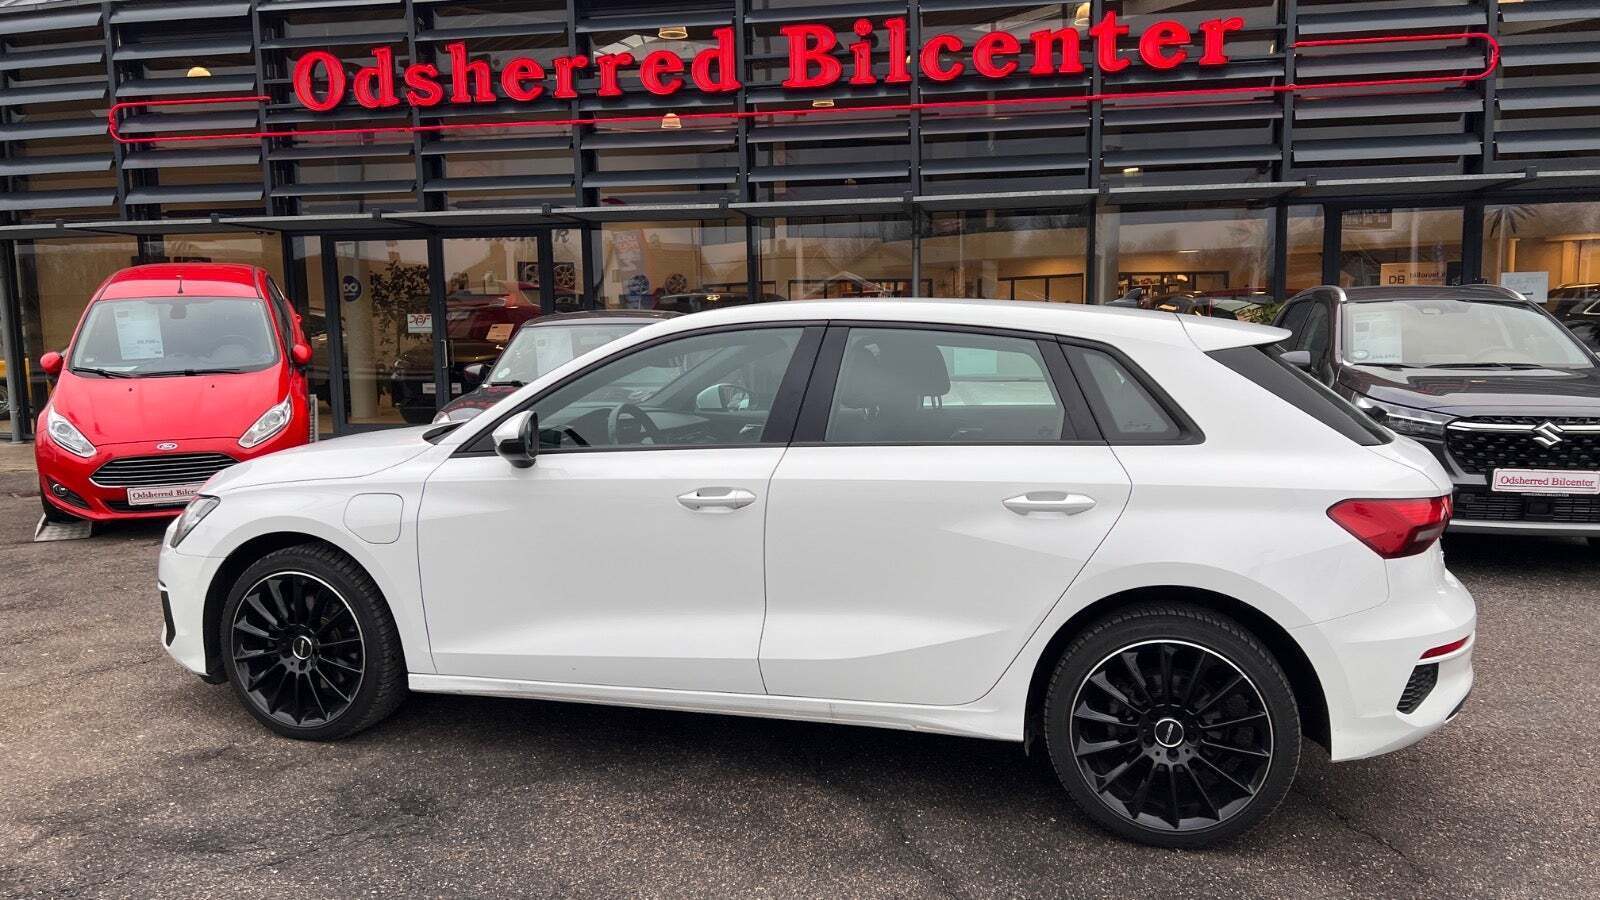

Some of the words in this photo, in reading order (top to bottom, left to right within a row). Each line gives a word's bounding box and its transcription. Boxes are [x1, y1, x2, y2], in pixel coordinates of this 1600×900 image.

[292, 26, 742, 112] Odsherred
[781, 16, 1245, 90] Bilcenter
[1501, 475, 1549, 486] Odsherred
[1551, 478, 1595, 487] Bilcenter
[132, 490, 174, 500] Odsherred
